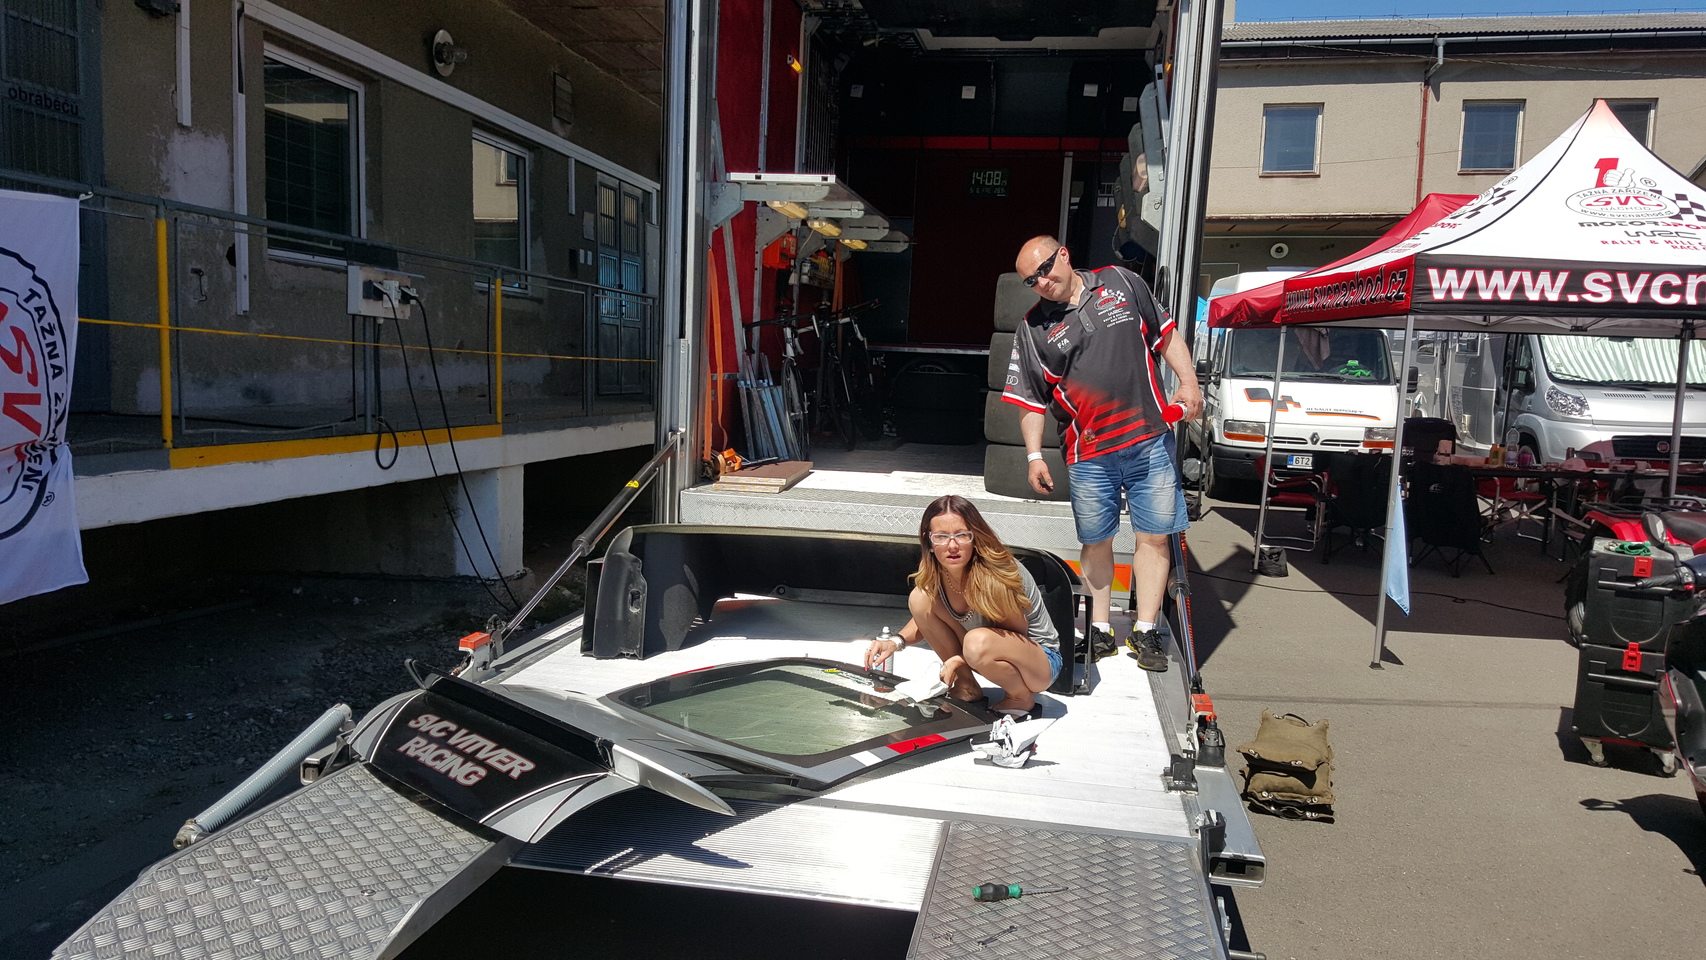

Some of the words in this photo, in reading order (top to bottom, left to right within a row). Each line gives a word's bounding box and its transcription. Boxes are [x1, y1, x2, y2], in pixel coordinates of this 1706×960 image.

[972, 171, 1002, 186] 14:08
[1585, 195, 1664, 207] SVC
[1623, 229, 1702, 240] WRC
[1286, 265, 1409, 314] www.svcnachod.cz
[407, 713, 459, 738] SVC
[397, 736, 488, 787] RACING
